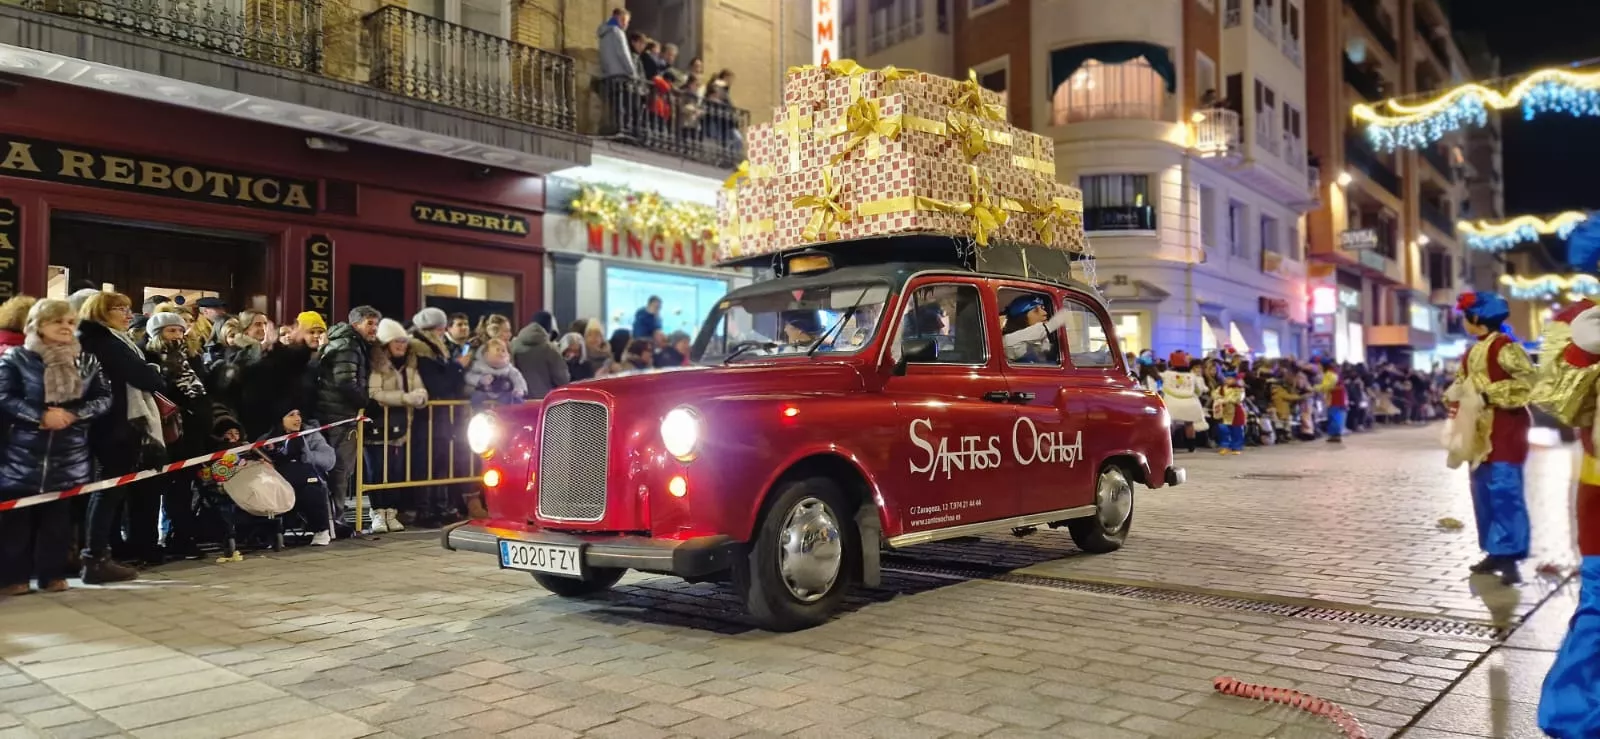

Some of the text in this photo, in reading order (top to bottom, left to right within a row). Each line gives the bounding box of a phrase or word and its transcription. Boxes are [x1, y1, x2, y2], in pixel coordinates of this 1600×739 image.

[0, 141, 312, 209] A REBOTICA
[415, 206, 527, 234] TAPERÍA
[586, 222, 719, 267] MINGAR
[309, 241, 329, 320] CERV
[1012, 416, 1083, 468] OCHOA
[511, 545, 575, 571] 2020 FZY
